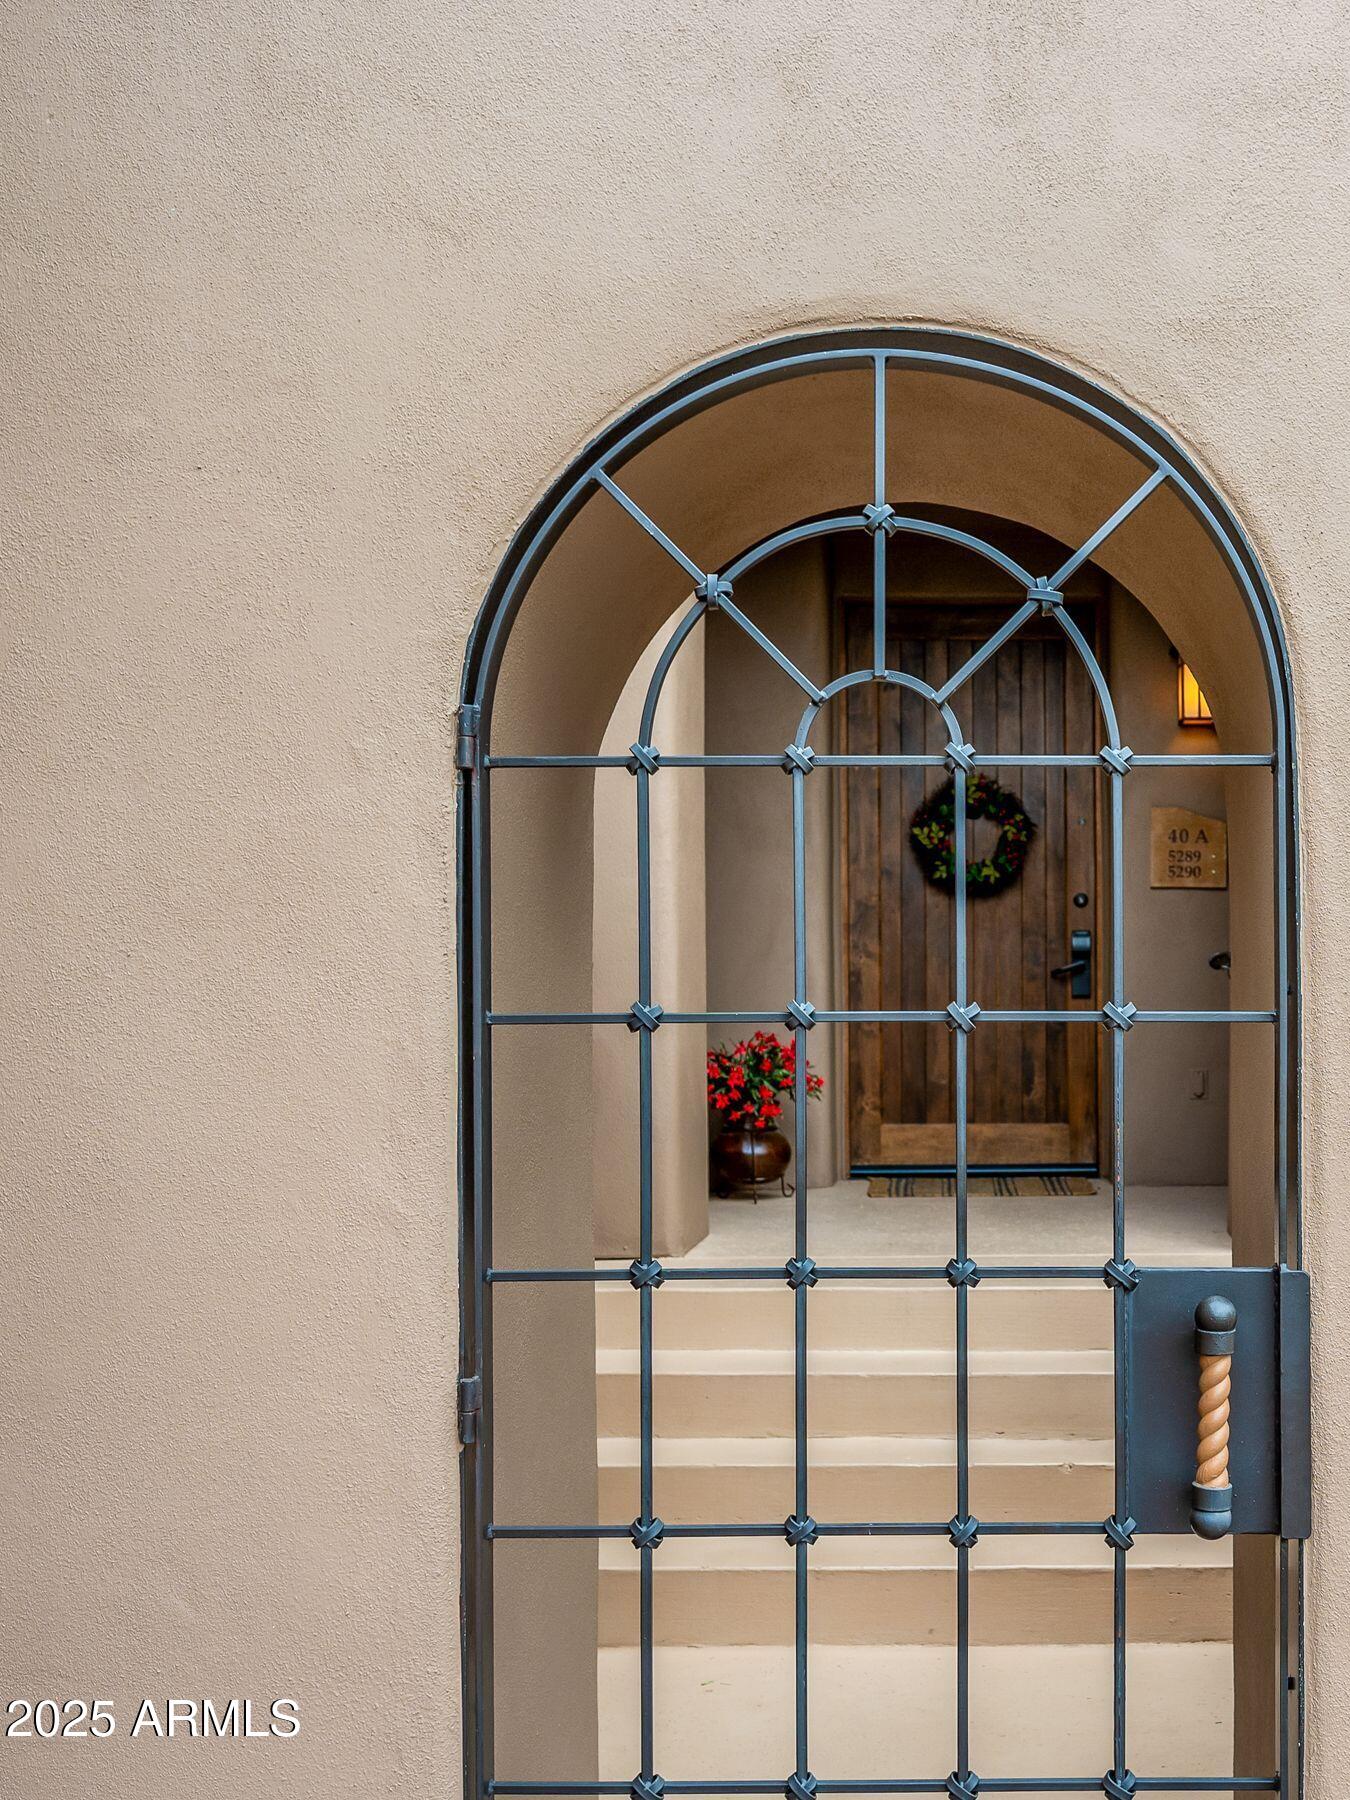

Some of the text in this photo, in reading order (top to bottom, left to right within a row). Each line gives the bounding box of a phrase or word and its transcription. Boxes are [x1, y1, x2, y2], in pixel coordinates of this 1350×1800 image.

[1168, 828, 1209, 844] 40 A
[1168, 850, 1201, 863] 5289
[1168, 865, 1201, 878] 5290
